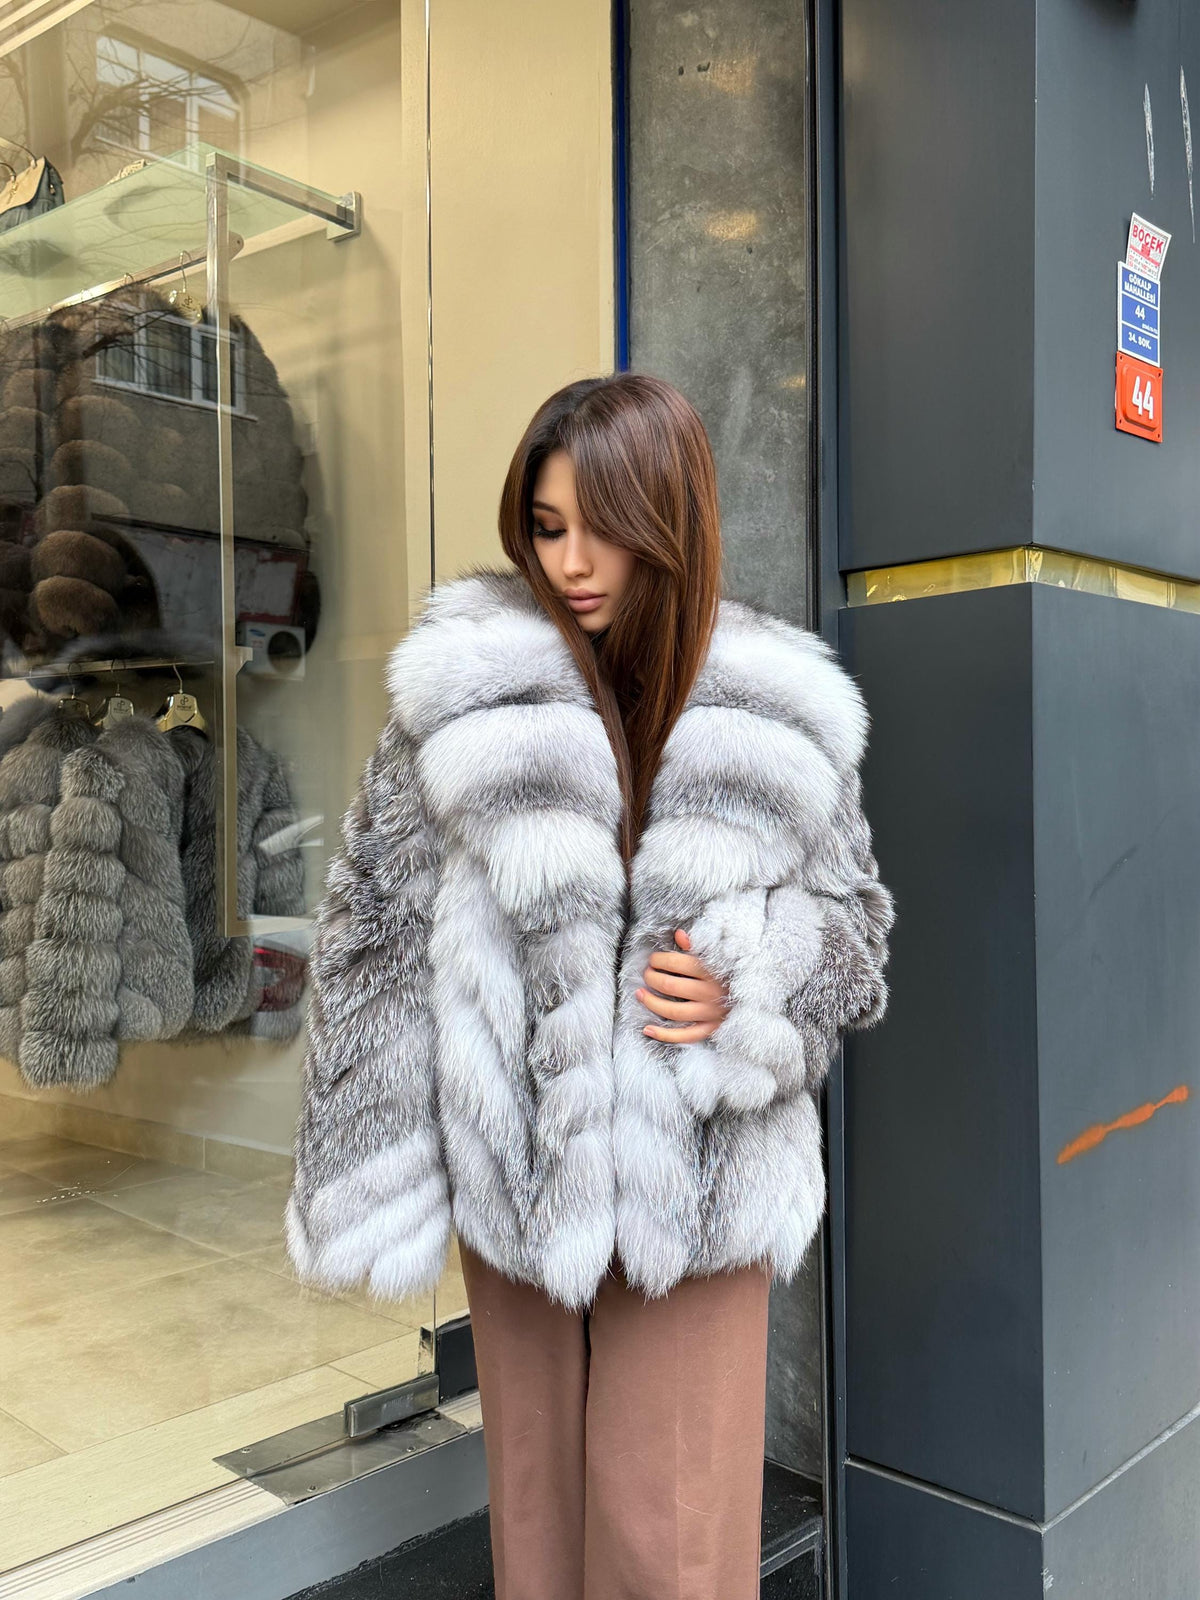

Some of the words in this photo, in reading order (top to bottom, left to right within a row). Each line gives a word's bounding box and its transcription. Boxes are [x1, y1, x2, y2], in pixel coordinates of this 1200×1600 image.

[1134, 304, 1146, 320] 44
[1138, 335, 1152, 350] SOK.
[1131, 375, 1154, 420] 44
